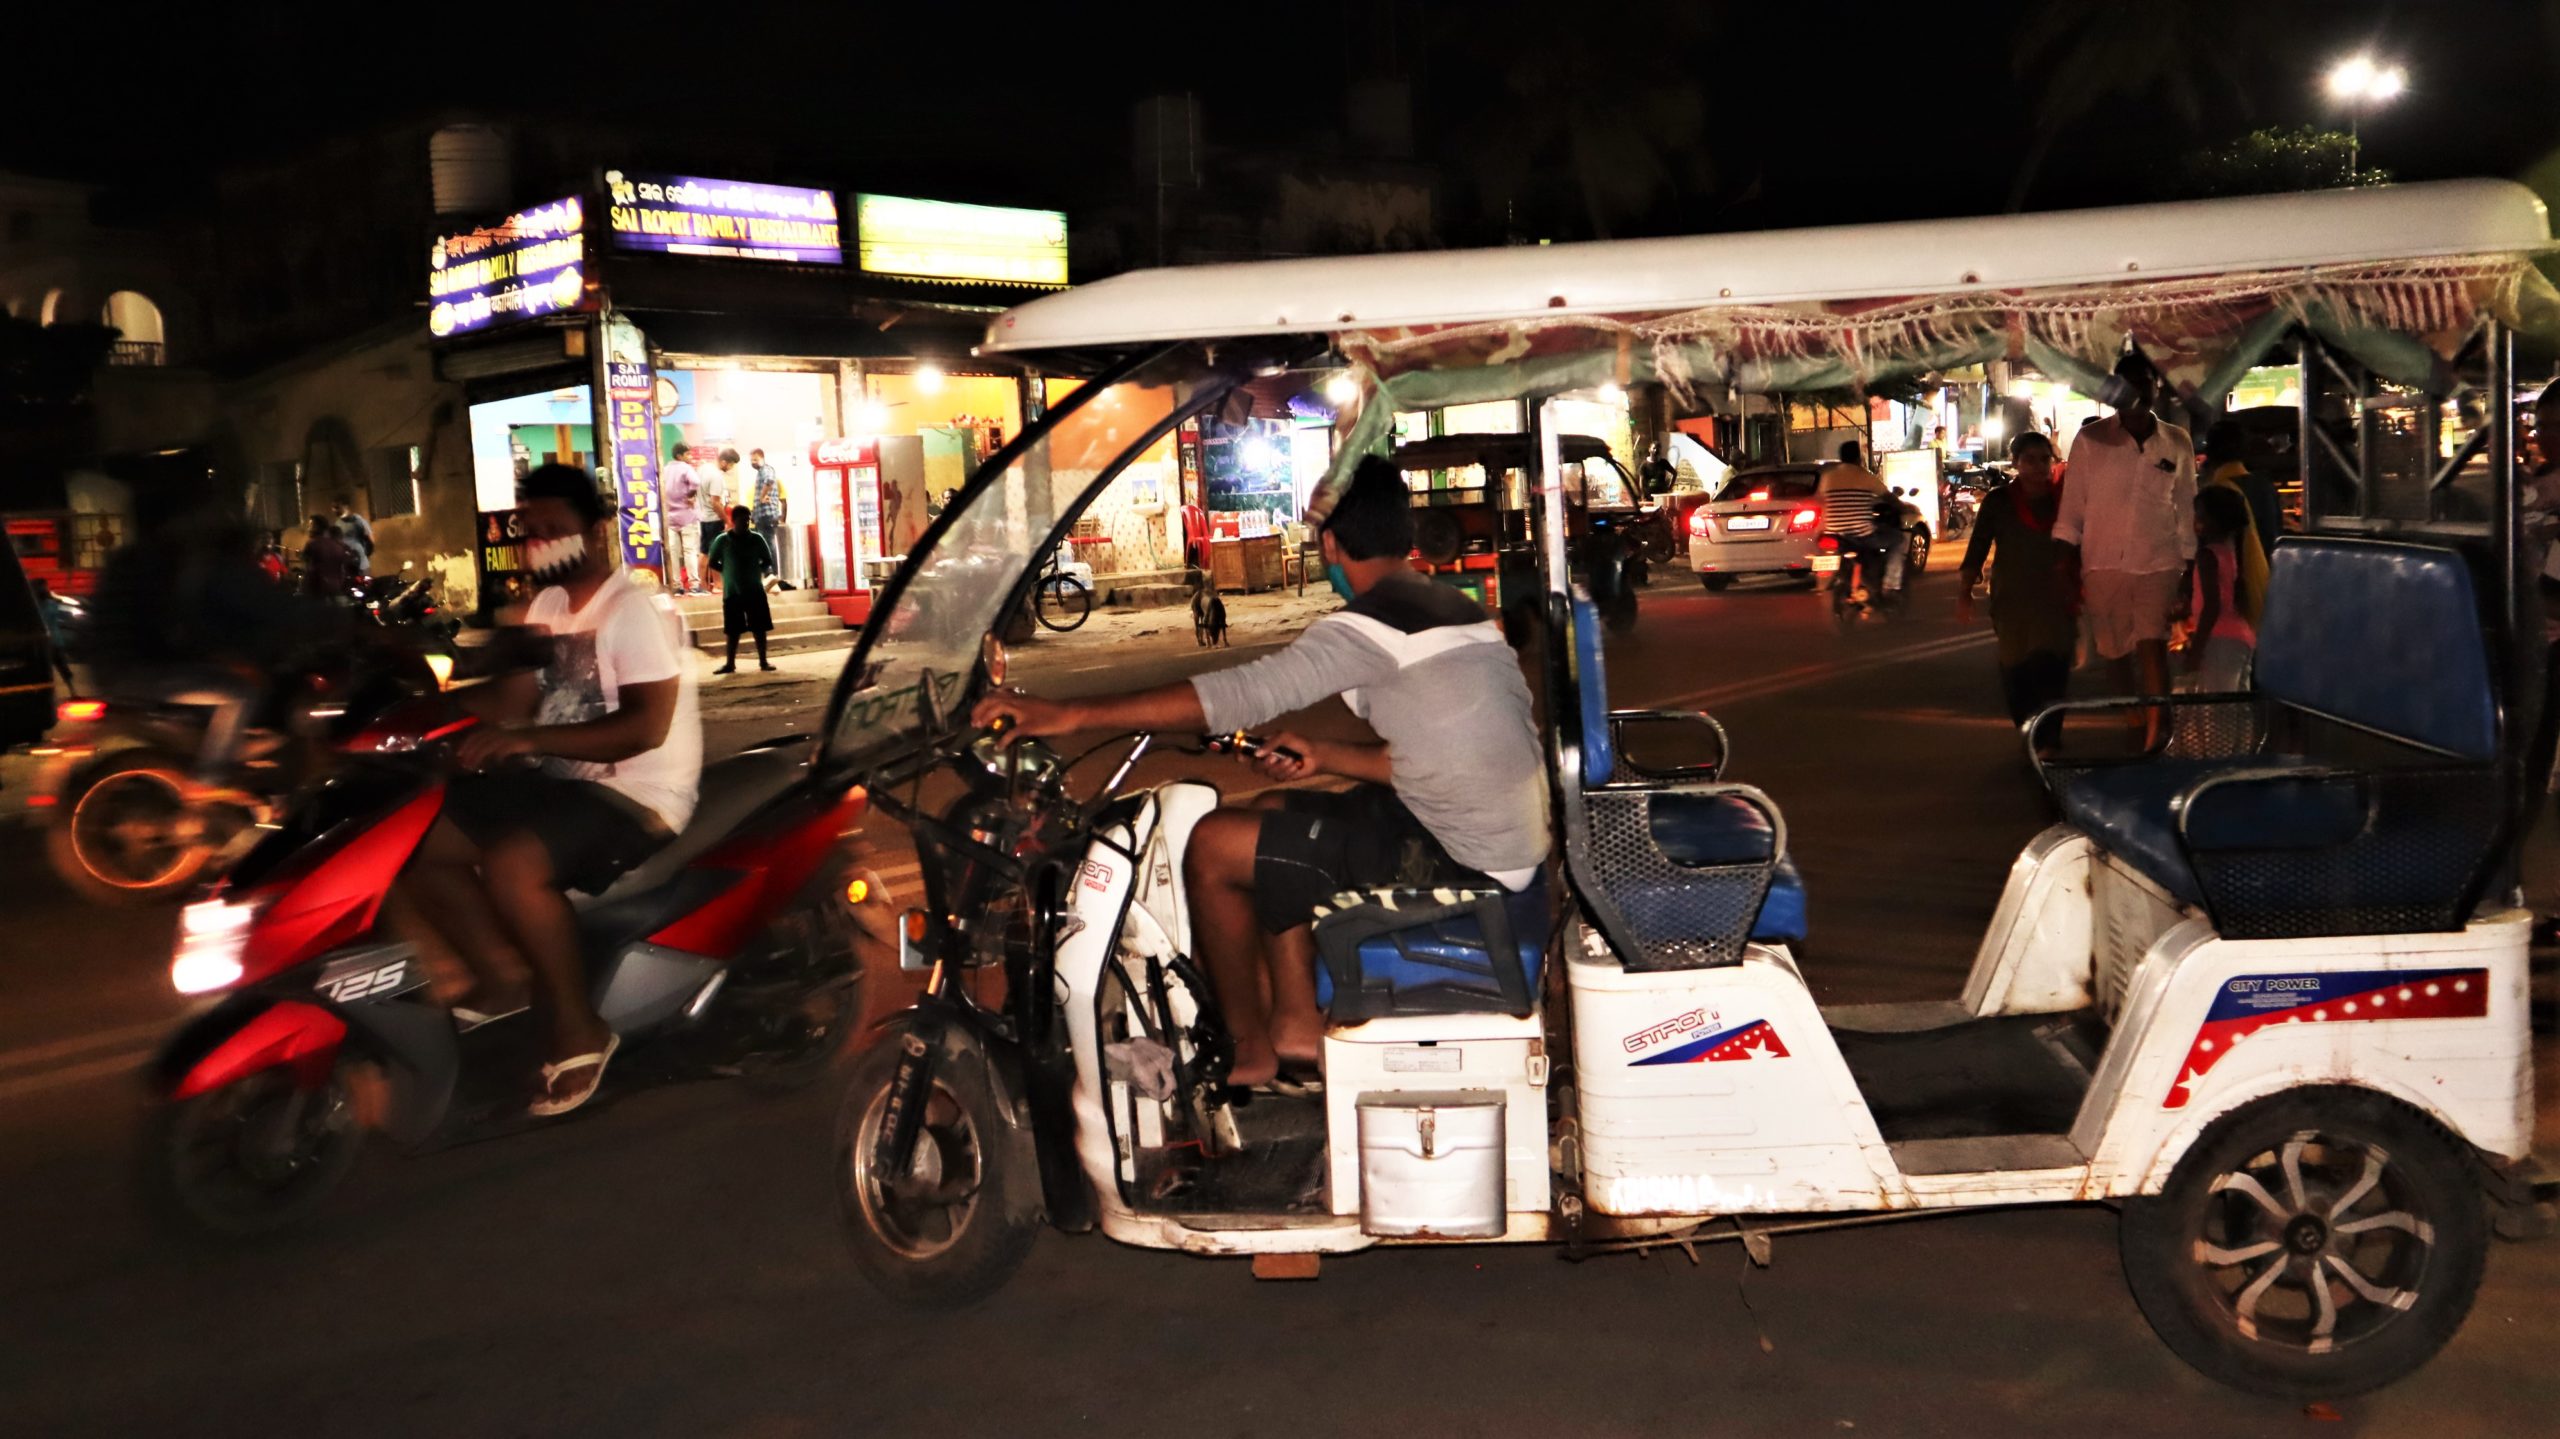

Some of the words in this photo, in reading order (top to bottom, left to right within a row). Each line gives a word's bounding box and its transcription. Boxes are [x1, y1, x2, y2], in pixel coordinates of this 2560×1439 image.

[611, 207, 640, 232] SAI
[640, 209, 691, 236] ROMIT
[693, 213, 748, 240] FAMILY
[480, 253, 514, 285] FAMILY
[612, 375, 648, 387] ROMIT
[618, 364, 641, 374] SAI
[620, 401, 648, 440] DUM
[624, 453, 654, 559] BIRIYANI
[329, 960, 407, 1003] 125
[2229, 980, 2263, 992] CITY
[2266, 978, 2320, 991] POWER
[1623, 1008, 1720, 1053] ETRON
